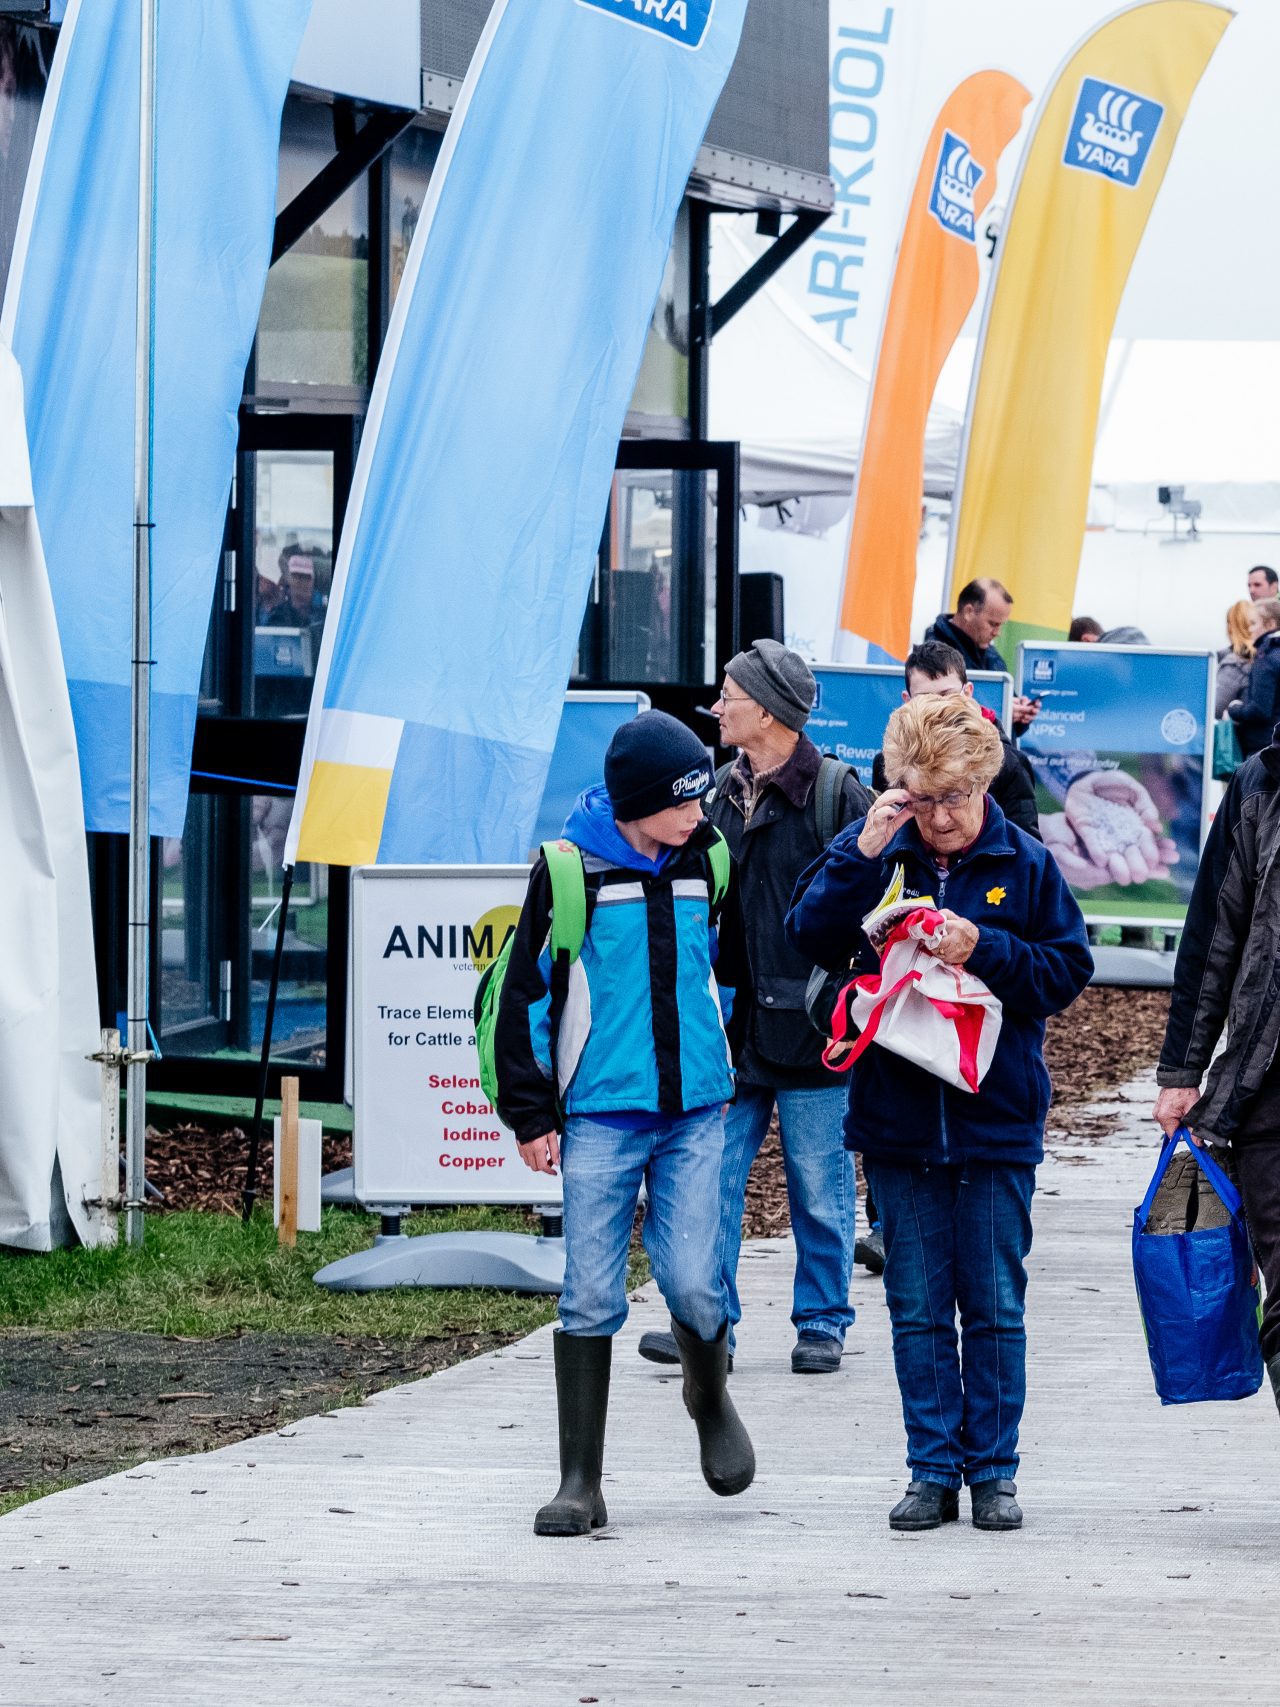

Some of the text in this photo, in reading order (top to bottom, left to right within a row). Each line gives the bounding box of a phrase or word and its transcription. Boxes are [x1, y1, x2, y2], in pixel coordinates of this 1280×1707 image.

[1076, 141, 1129, 177] YARA
[1036, 710, 1085, 723] alanced
[377, 1004, 475, 1020] Trace Eleme
[388, 1031, 411, 1046] for
[416, 1031, 462, 1046] Cattle
[428, 1074, 480, 1089] Selen
[443, 1127, 501, 1142] Iodine
[438, 1153, 506, 1171] Copper
